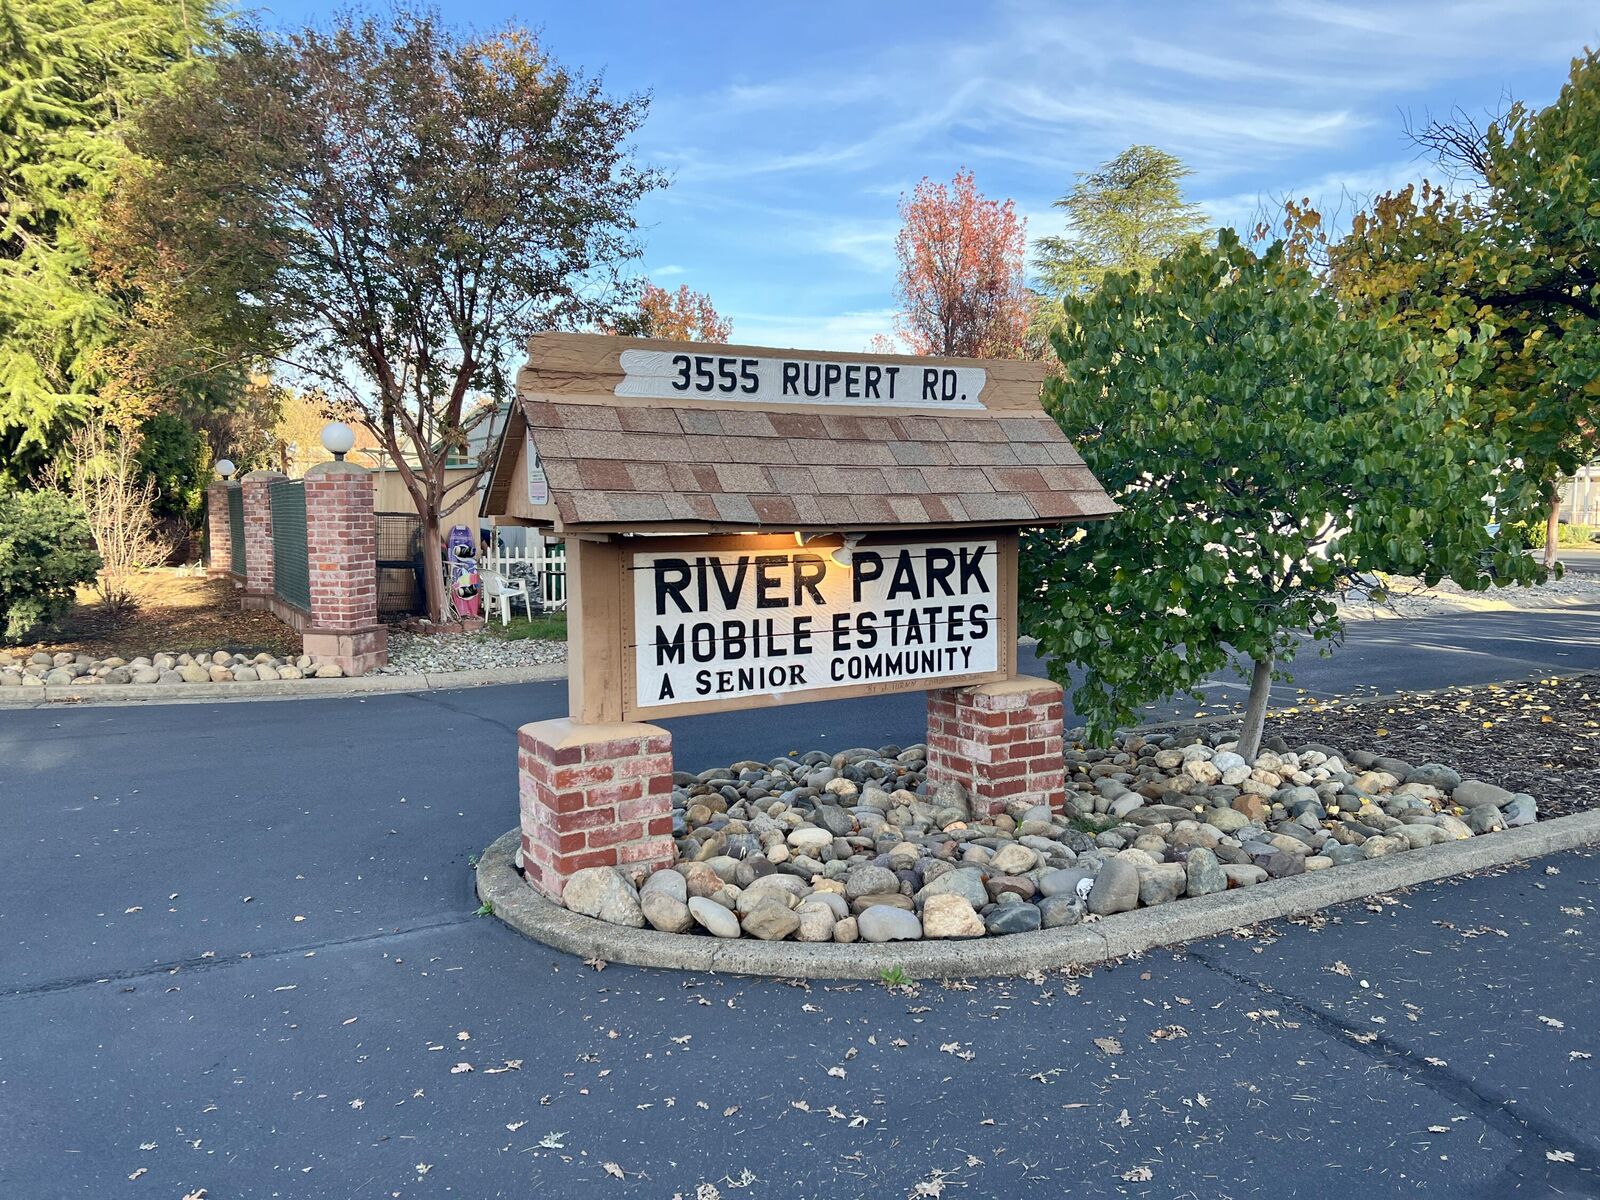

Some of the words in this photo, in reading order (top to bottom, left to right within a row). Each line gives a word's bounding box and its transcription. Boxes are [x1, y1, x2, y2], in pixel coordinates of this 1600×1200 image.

[672, 355, 759, 393] 3555
[782, 362, 900, 399] RUPERT
[922, 368, 967, 400] RD.
[653, 553, 827, 615] RIVER
[852, 545, 991, 603] PARK
[656, 615, 813, 666] MOBILE
[832, 604, 989, 652] ESTATES
[658, 672, 675, 700] A
[695, 664, 807, 695] SENIOR
[830, 645, 973, 681] COMMUNITY
